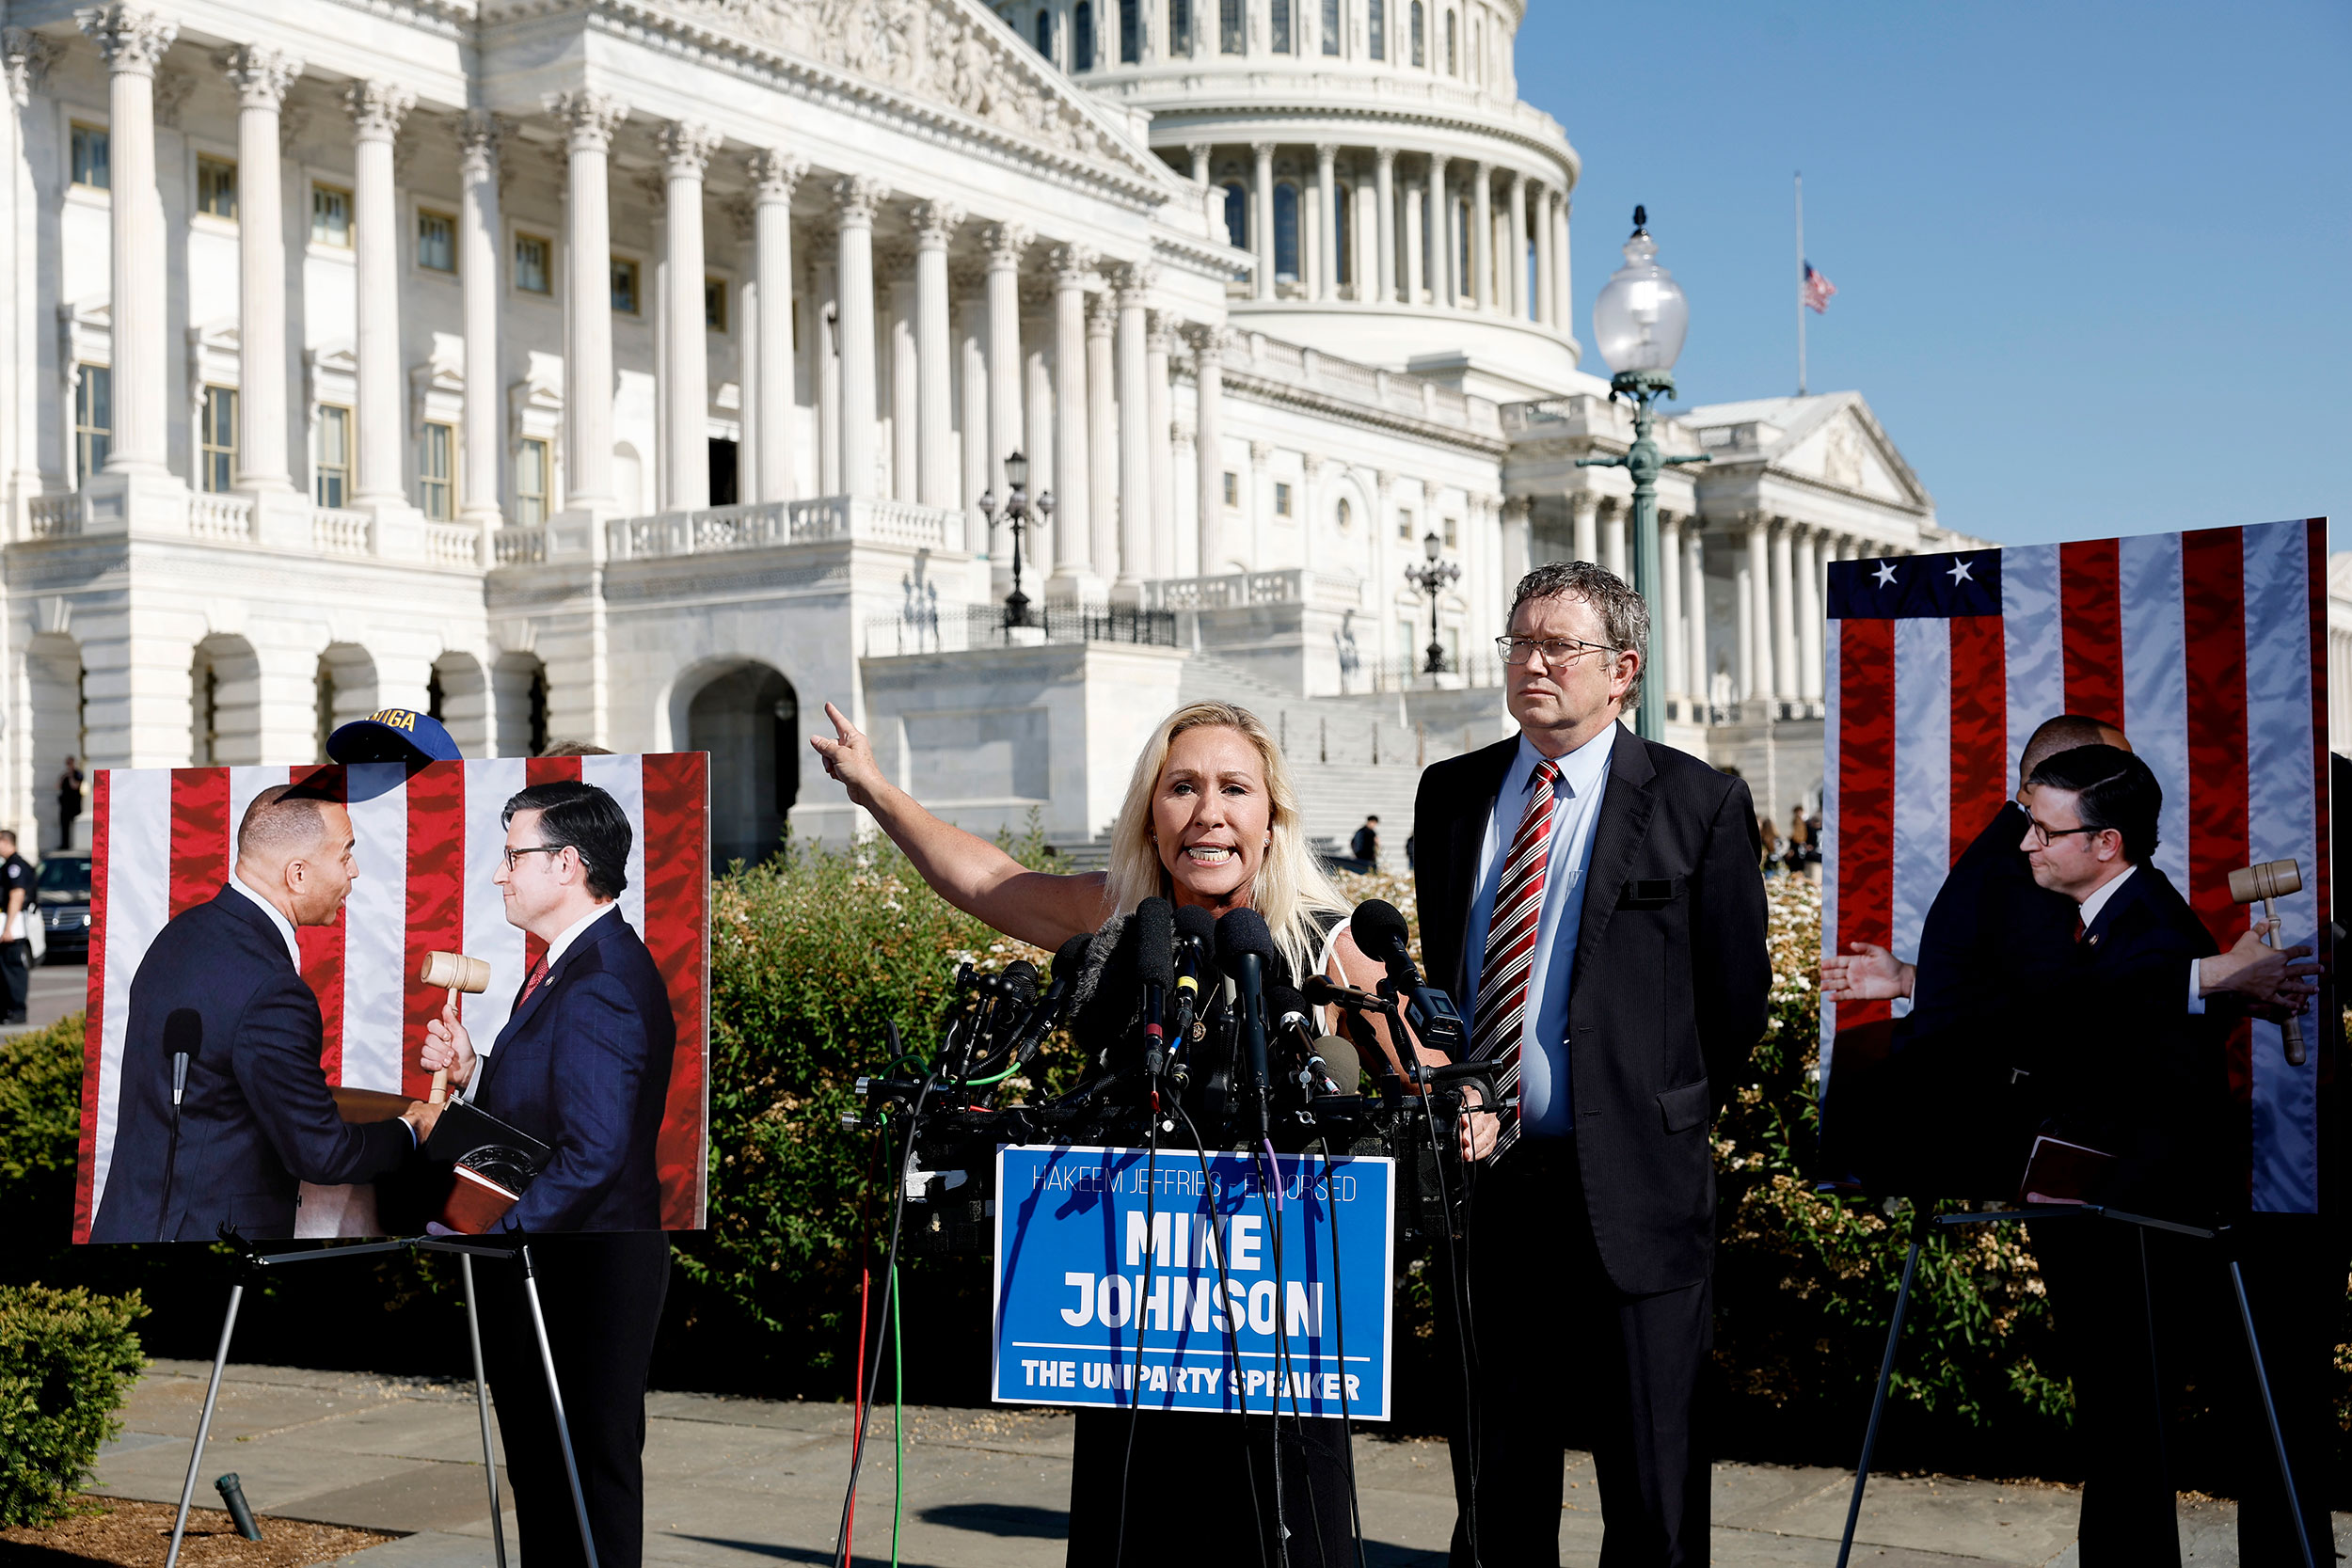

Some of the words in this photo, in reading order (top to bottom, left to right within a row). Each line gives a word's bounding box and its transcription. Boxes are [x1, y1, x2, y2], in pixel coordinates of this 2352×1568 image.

[364, 708, 416, 733] GA
[1033, 1165, 1123, 1194] HAKEEM
[1129, 1168, 1222, 1197] JEFFRIES
[1244, 1172, 1357, 1202] ENDORSED
[1125, 1210, 1263, 1271] MIKE
[1060, 1271, 1324, 1338] JOHNSON
[1021, 1359, 1075, 1387] THE
[1082, 1362, 1223, 1395] UNIPARTY
[1228, 1369, 1360, 1402] SPEAKER
